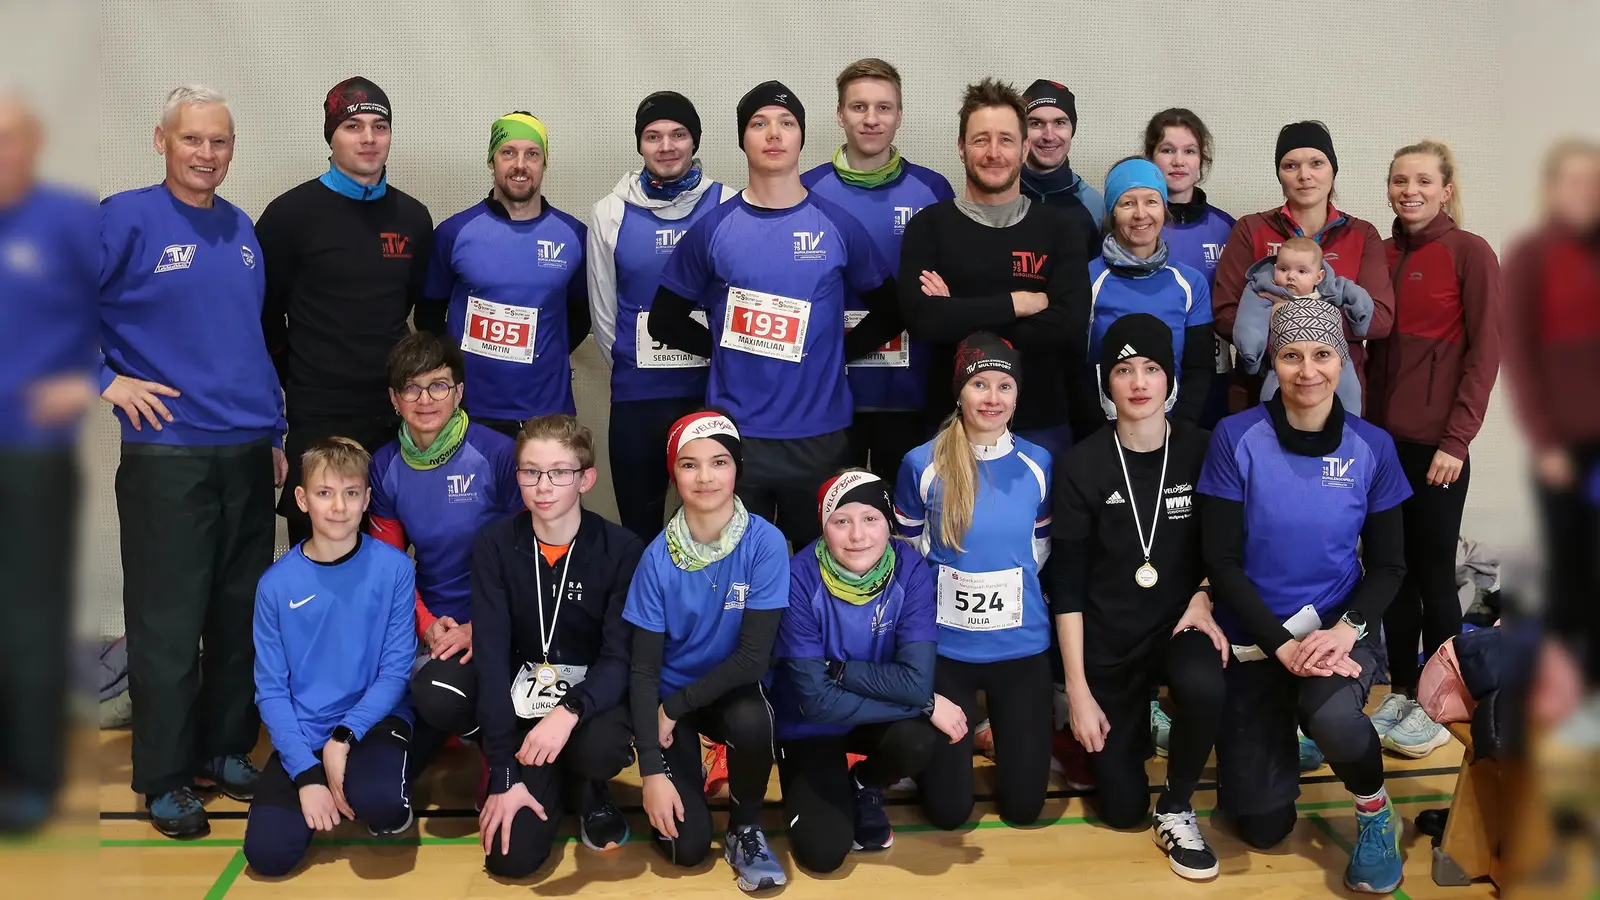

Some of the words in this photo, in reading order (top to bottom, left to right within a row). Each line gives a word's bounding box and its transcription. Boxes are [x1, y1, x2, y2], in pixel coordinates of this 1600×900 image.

[347, 103, 359, 113] TV
[380, 232, 409, 254] TV
[655, 229, 688, 246] TV
[793, 231, 825, 251] TV
[166, 246, 193, 262] TV
[537, 240, 566, 259] TV
[1012, 251, 1048, 273] TV
[479, 319, 520, 344] 195
[743, 311, 788, 339] 193
[481, 342, 510, 354] MARTIN
[738, 335, 785, 351] MAXIMILIAN
[653, 354, 693, 362] SEBASTIAN
[977, 362, 1012, 371] MULTISPORT
[966, 363, 977, 374] TV
[1322, 456, 1356, 477] TV
[446, 473, 476, 494] TV
[1165, 495, 1193, 508] WWK
[955, 590, 1004, 613] 524
[531, 702, 556, 710] LUKAS
